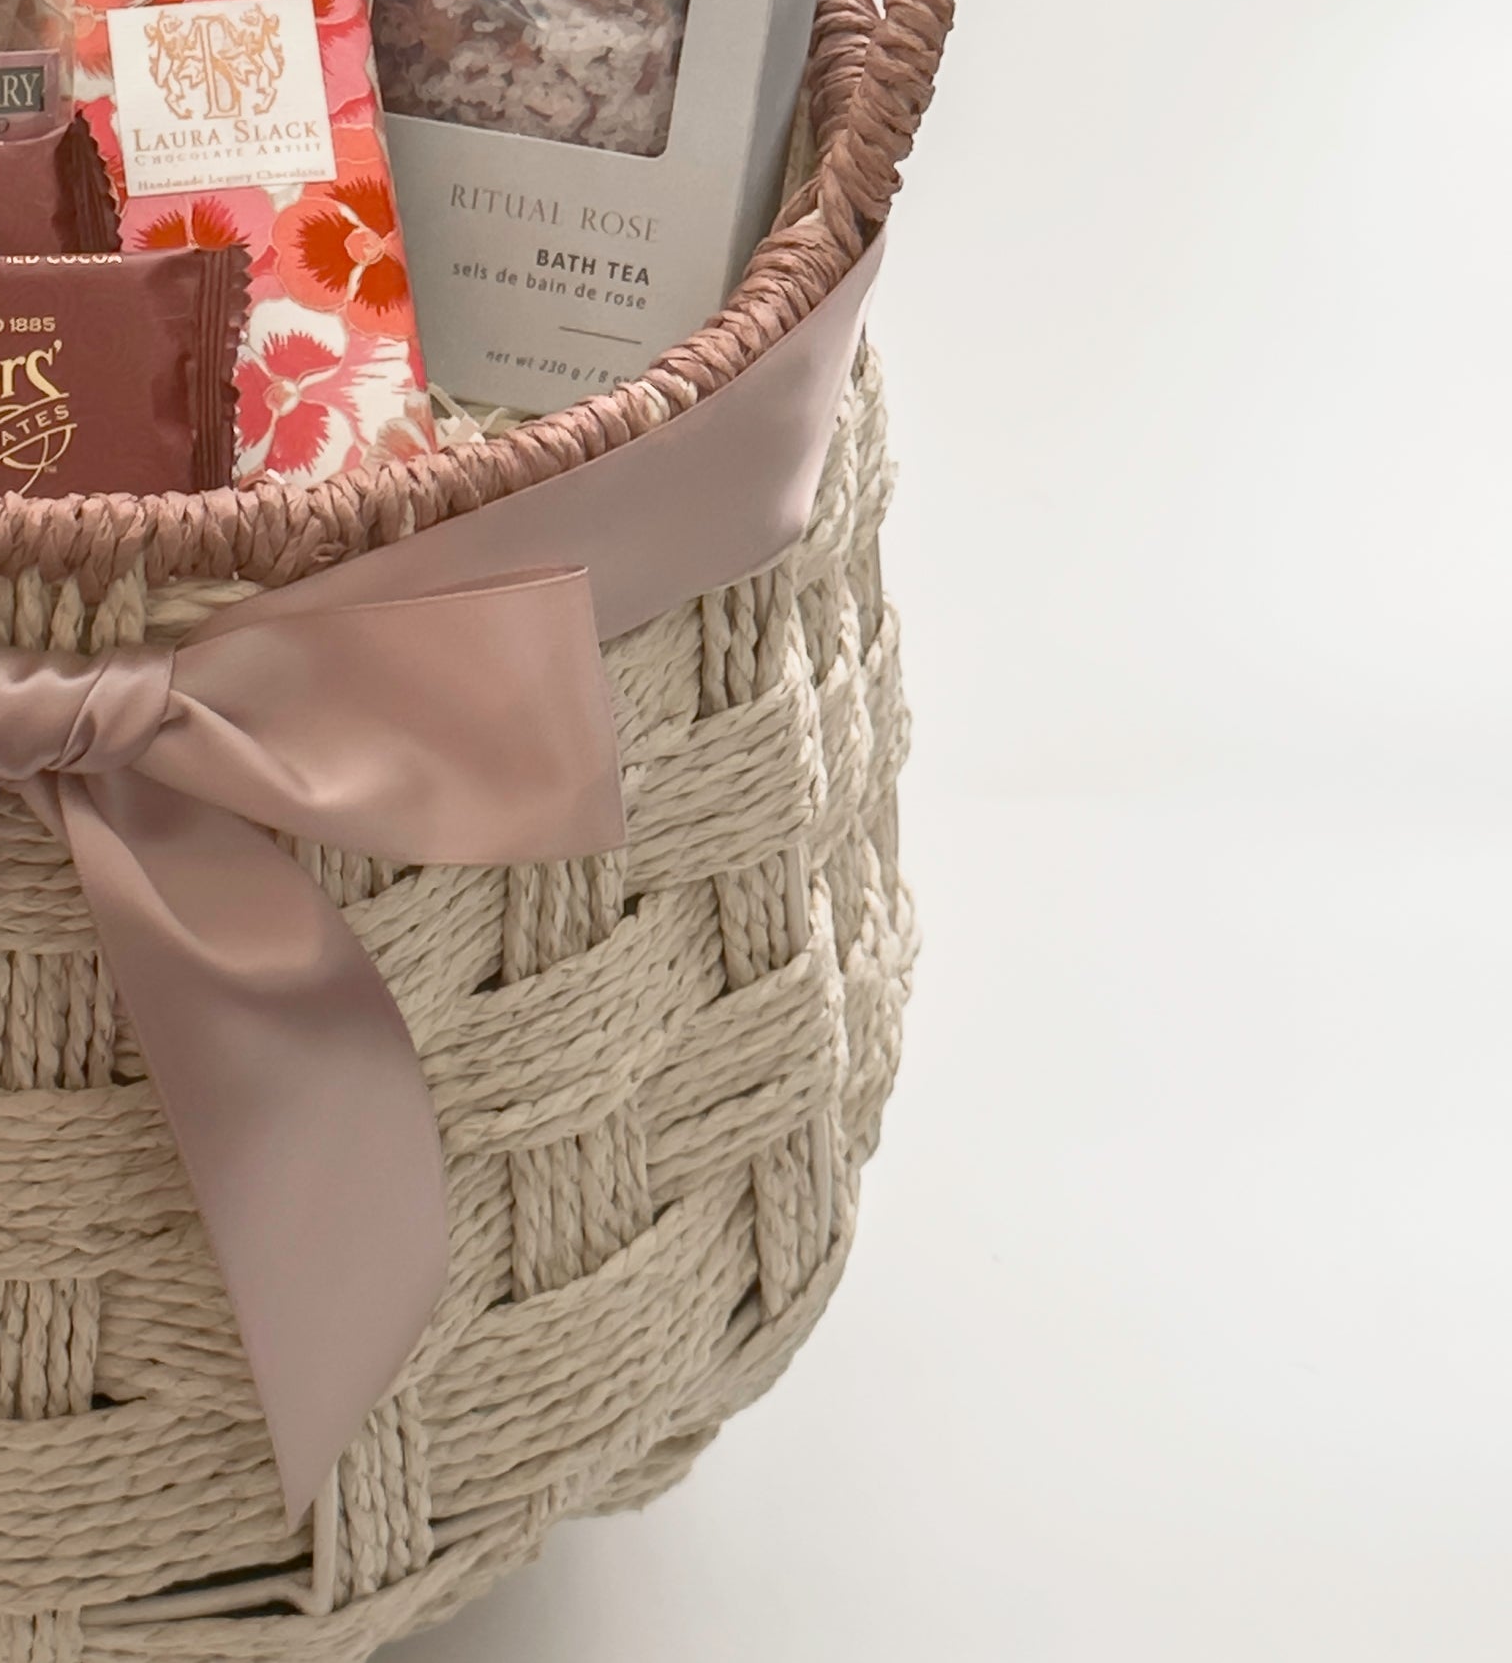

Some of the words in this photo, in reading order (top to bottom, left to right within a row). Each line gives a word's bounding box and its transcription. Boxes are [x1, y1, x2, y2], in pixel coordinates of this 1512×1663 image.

[133, 128, 223, 153] LAURA
[233, 119, 320, 144] SLACK
[450, 183, 564, 226] RITUAL
[580, 205, 662, 243] ROSE
[451, 260, 489, 280] sels
[495, 267, 520, 286] de
[525, 273, 568, 296] bain
[575, 281, 598, 300] de
[604, 291, 648, 310] rose
[536, 248, 598, 276] BATH
[607, 262, 651, 286] TEA
[9, 317, 57, 333] 1885
[486, 350, 511, 364] net
[515, 356, 536, 369] wt
